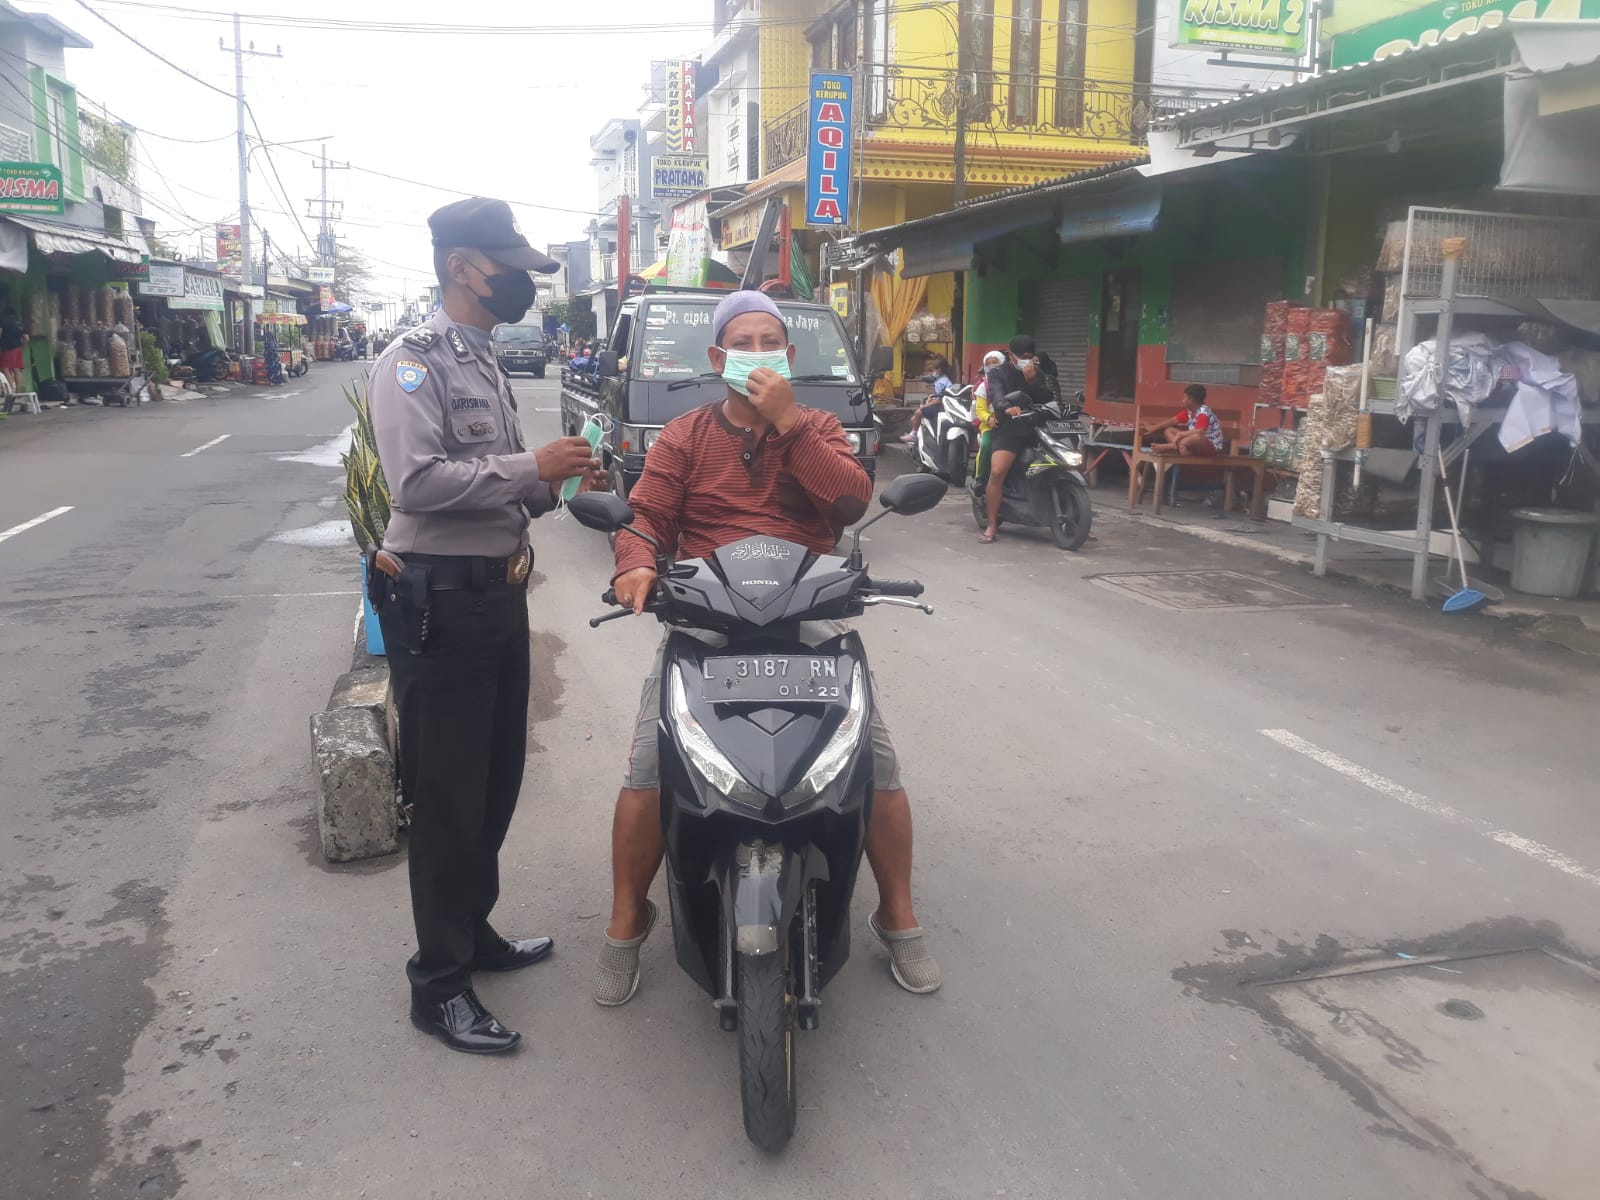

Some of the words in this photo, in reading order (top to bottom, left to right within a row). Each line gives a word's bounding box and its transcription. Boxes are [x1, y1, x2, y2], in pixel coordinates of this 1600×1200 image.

[822, 81, 841, 89] TOKO
[816, 90, 847, 99] KERUPUK
[685, 61, 694, 151] PRATAMA
[814, 103, 845, 218] AQILA
[655, 169, 704, 186] PRATAMA
[795, 315, 820, 331] Jaya
[703, 661, 715, 679] L
[736, 659, 789, 678] 3187
